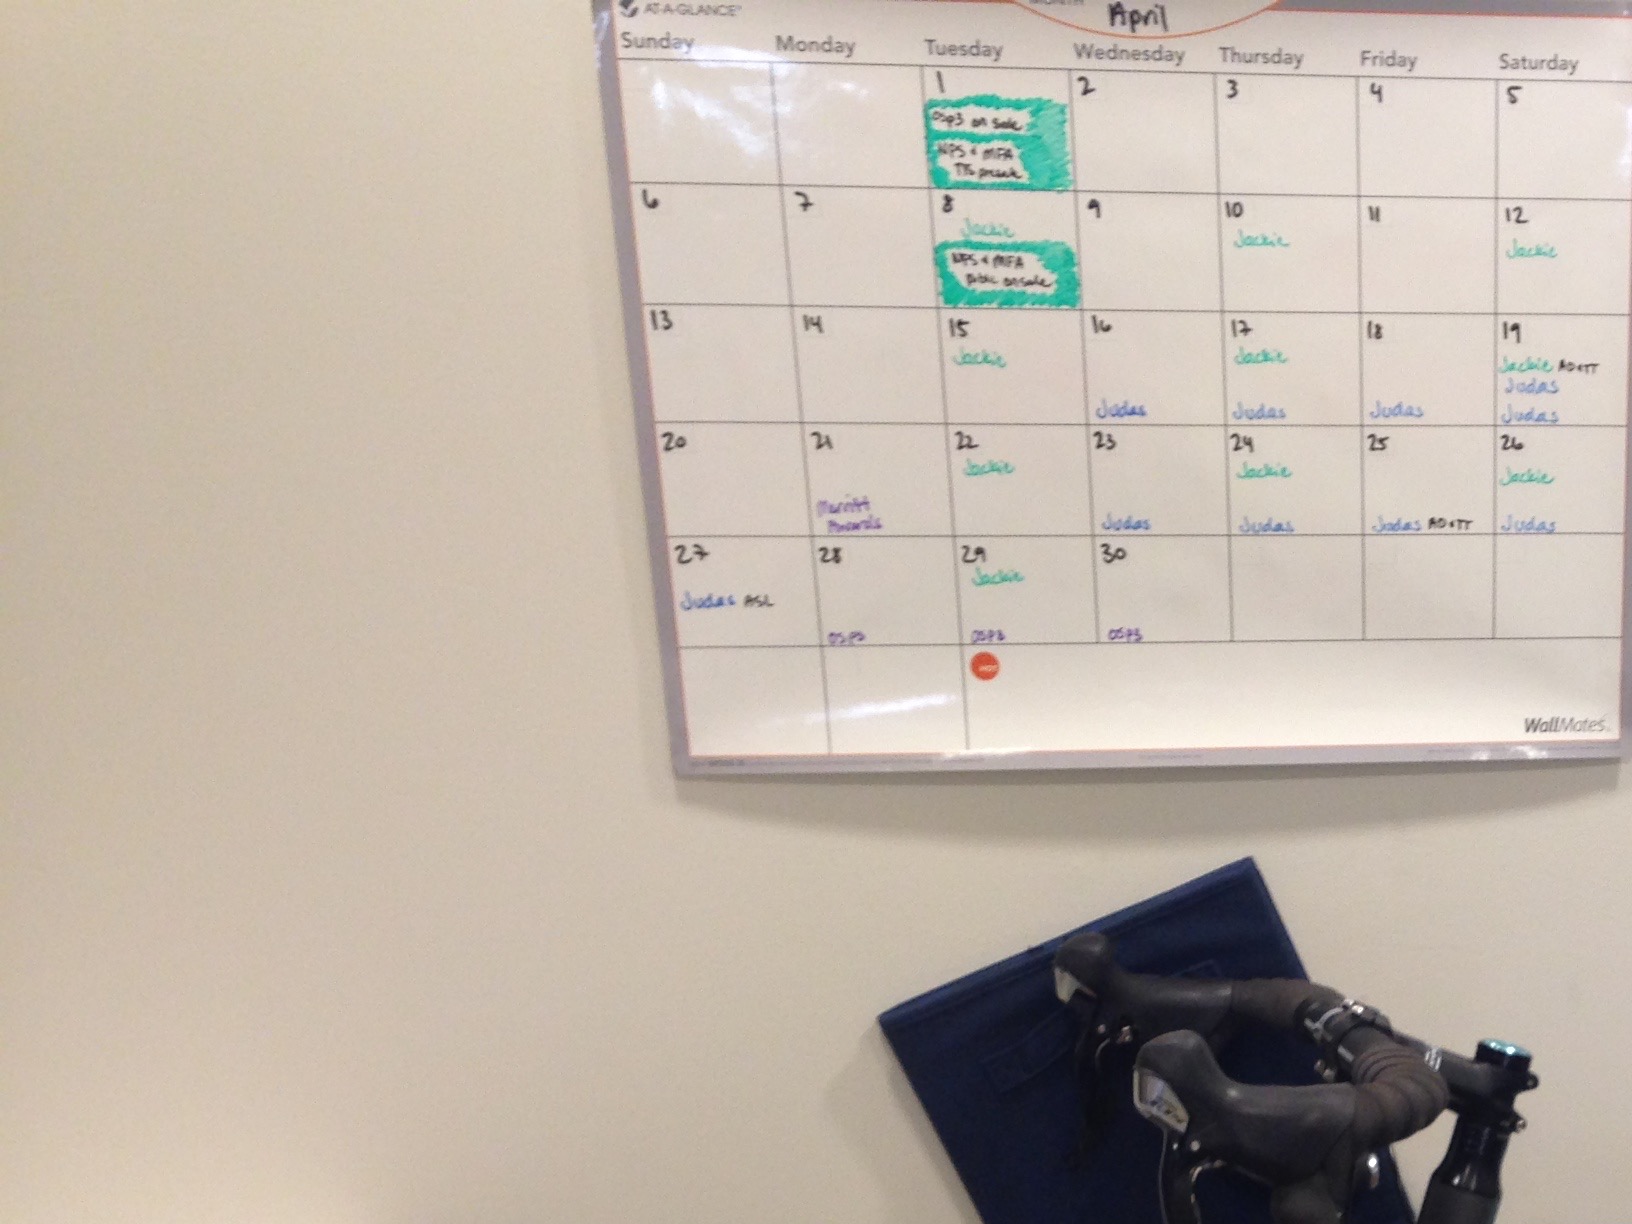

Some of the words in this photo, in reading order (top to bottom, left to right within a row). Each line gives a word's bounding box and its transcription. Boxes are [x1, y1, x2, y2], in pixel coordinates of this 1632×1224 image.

[1108, 1, 1168, 33] April
[620, 31, 695, 54] Sunday
[775, 35, 857, 58] Monday
[925, 39, 1004, 61] Tuesday
[1072, 42, 1187, 67] Wednesday
[1219, 46, 1305, 69] Thursday
[1360, 51, 1419, 72] Friday
[1499, 53, 1579, 75] Saturday
[935, 72, 945, 94] 1
[1078, 76, 1097, 96] 2
[1226, 79, 1240, 99] 3
[1369, 83, 1384, 103] 4
[1506, 86, 1522, 104] 5
[641, 189, 660, 210] 6
[794, 192, 814, 212] 7
[942, 194, 956, 213] 8
[1086, 197, 1102, 219] 9
[1224, 200, 1245, 219] 10
[1367, 206, 1382, 223] 11
[1504, 206, 1530, 225] 12
[1232, 229, 1291, 249] Jackie
[1506, 238, 1559, 261] Jackie
[650, 309, 674, 332] 13
[802, 314, 824, 334] 14
[949, 317, 970, 340] 15
[1090, 314, 1113, 335] 16
[1231, 319, 1255, 339] 17
[1367, 321, 1384, 341] 18
[1501, 321, 1523, 345] 19
[951, 347, 1009, 369] Jackie
[1233, 346, 1290, 366] Jackie
[1498, 355, 1555, 375] Jackie
[1505, 377, 1559, 395] Judas
[1095, 400, 1148, 420] Judas
[1231, 400, 1288, 422] Judas
[1368, 400, 1426, 420] Judas
[1501, 403, 1559, 424] Judas
[661, 430, 688, 452] 20
[810, 430, 834, 451] 21
[954, 429, 980, 451] 22
[1092, 429, 1117, 451] 23
[1230, 432, 1255, 454] 24
[1367, 433, 1391, 454] 25
[1500, 433, 1525, 452] 26
[962, 457, 1017, 478] Jackie
[1234, 459, 1293, 480] Jackie
[1499, 464, 1556, 487] Jackie
[1101, 513, 1152, 532] Judas
[1237, 515, 1295, 534] Judas
[1371, 514, 1422, 533] Judas
[1500, 515, 1557, 534] Judas
[674, 544, 710, 565] 27
[818, 546, 843, 565] 28
[961, 543, 988, 564] 29
[1100, 542, 1128, 563] 30
[972, 567, 1027, 588] Jackie
[680, 590, 737, 612] Judas
[1523, 715, 1606, 735] WallMates
